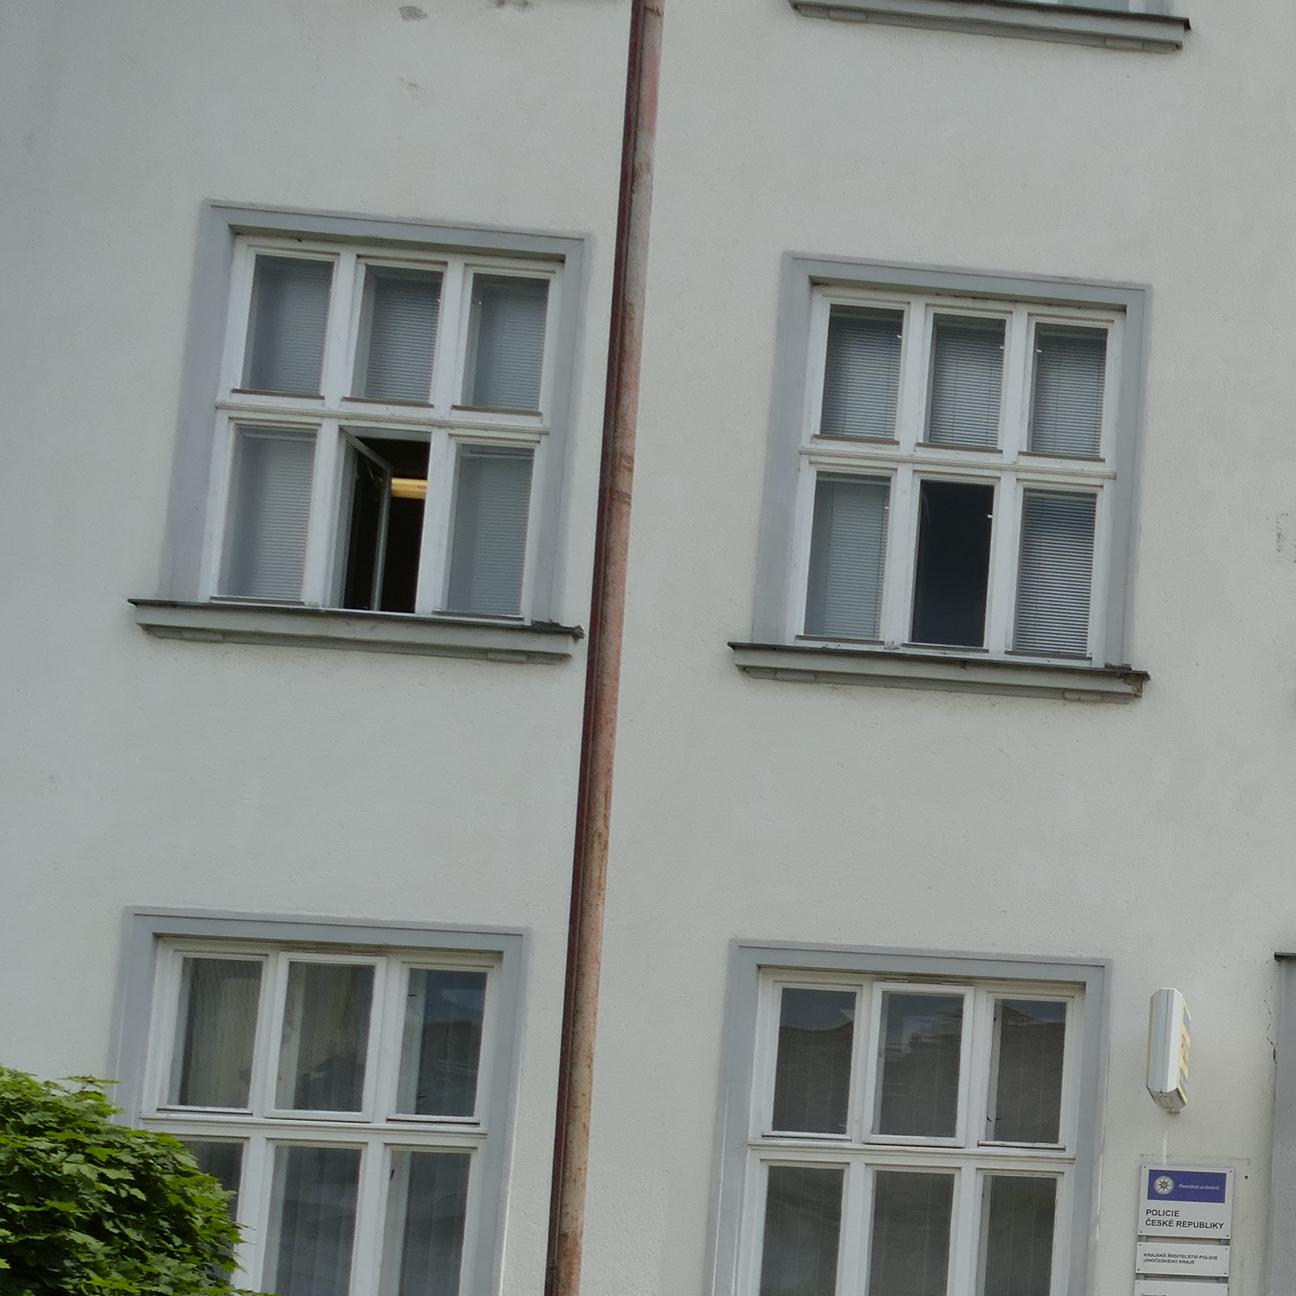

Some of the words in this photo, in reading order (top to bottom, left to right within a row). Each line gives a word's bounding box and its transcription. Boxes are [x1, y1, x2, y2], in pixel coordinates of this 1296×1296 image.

[1145, 1208, 1180, 1218] POLICIE
[1145, 1217, 1174, 1228] ČESKÉ
[1175, 1220, 1225, 1230] REPUBLIKY
